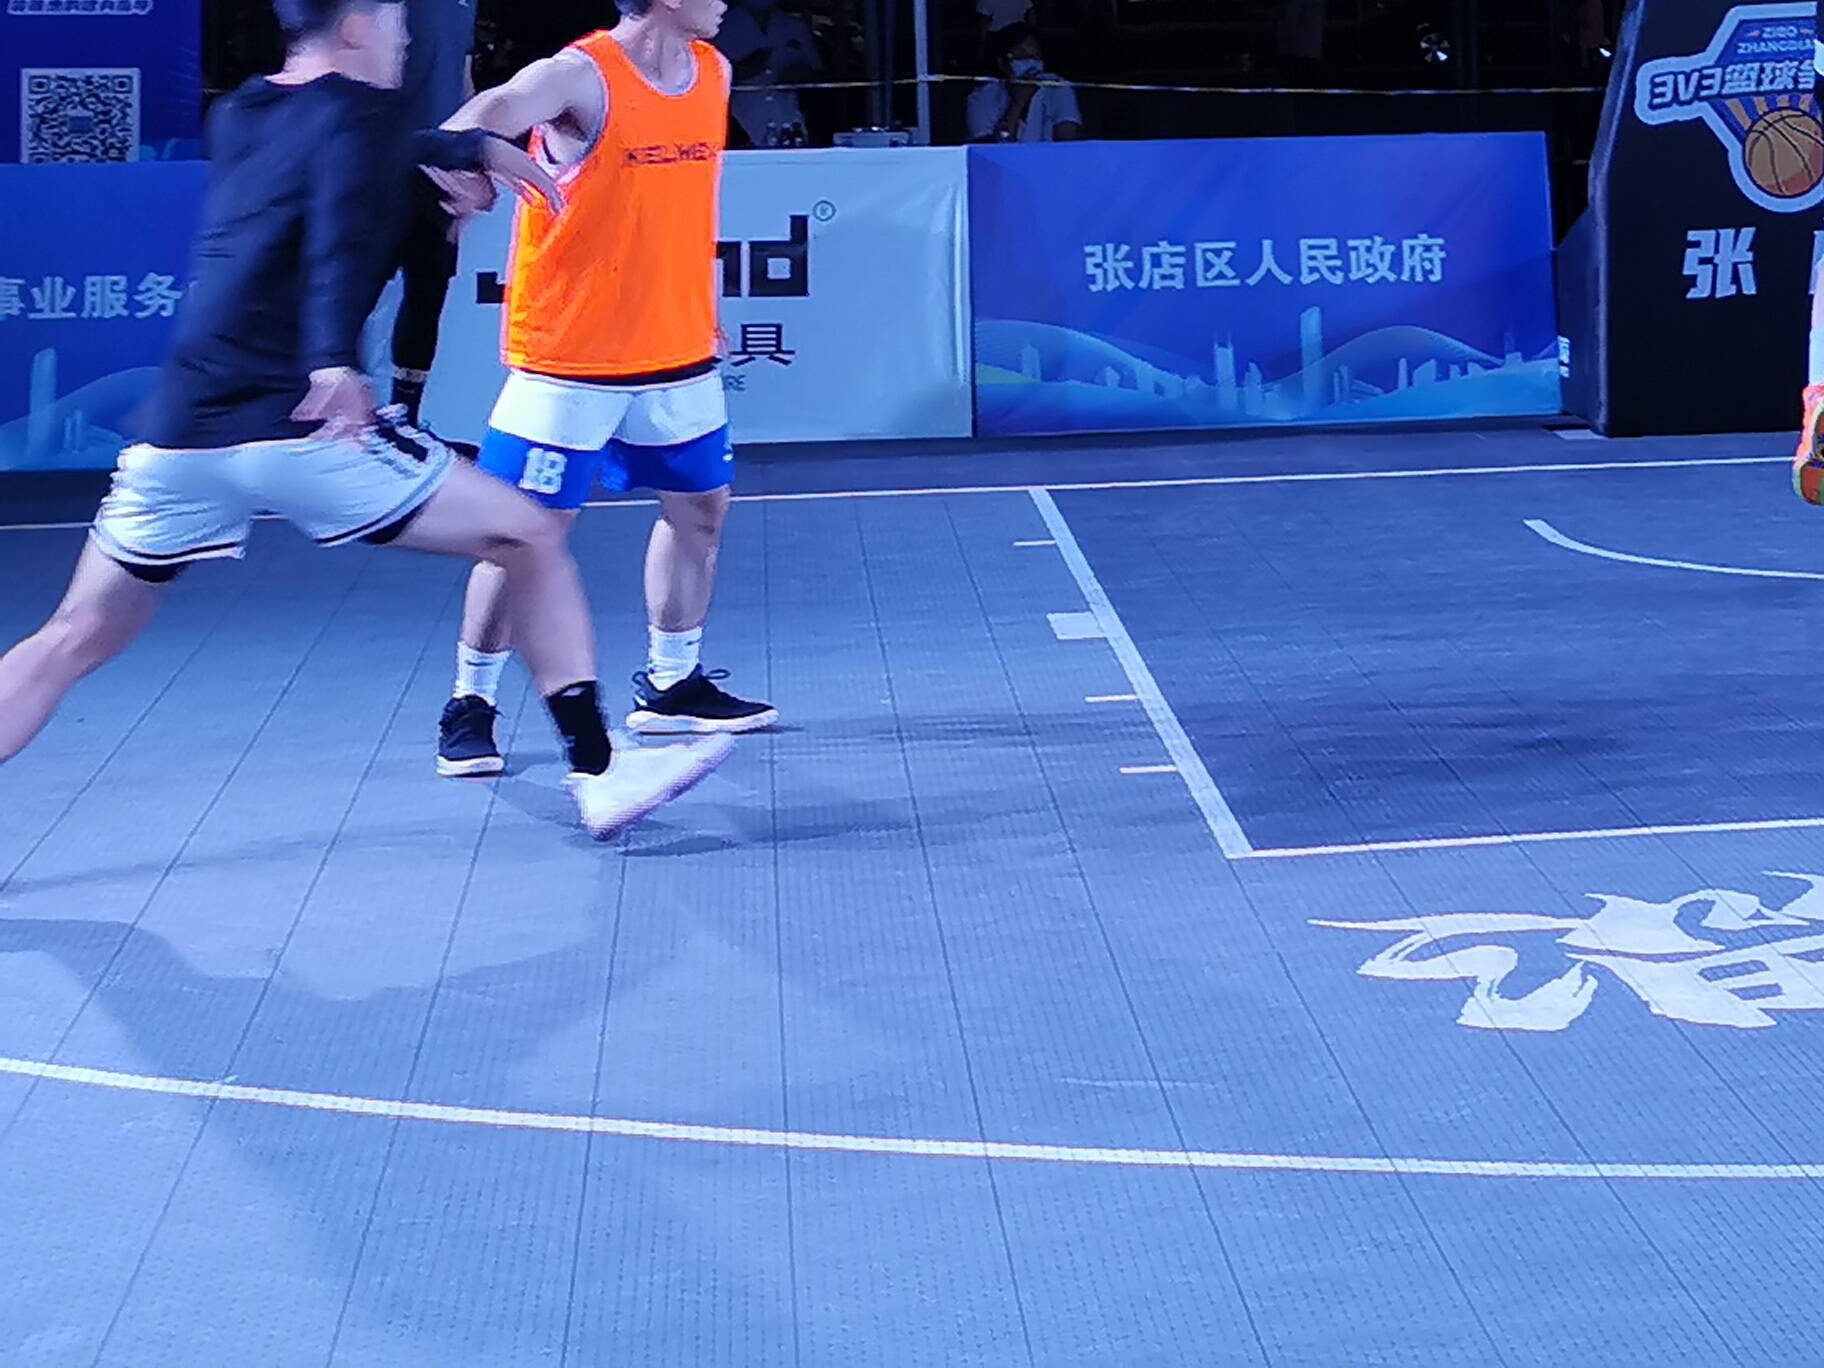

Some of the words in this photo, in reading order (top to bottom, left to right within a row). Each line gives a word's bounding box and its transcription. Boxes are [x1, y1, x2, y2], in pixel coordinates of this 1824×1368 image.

[1083, 233, 1447, 292] 张店区人民政府
[0, 272, 198, 319] 事业服务
